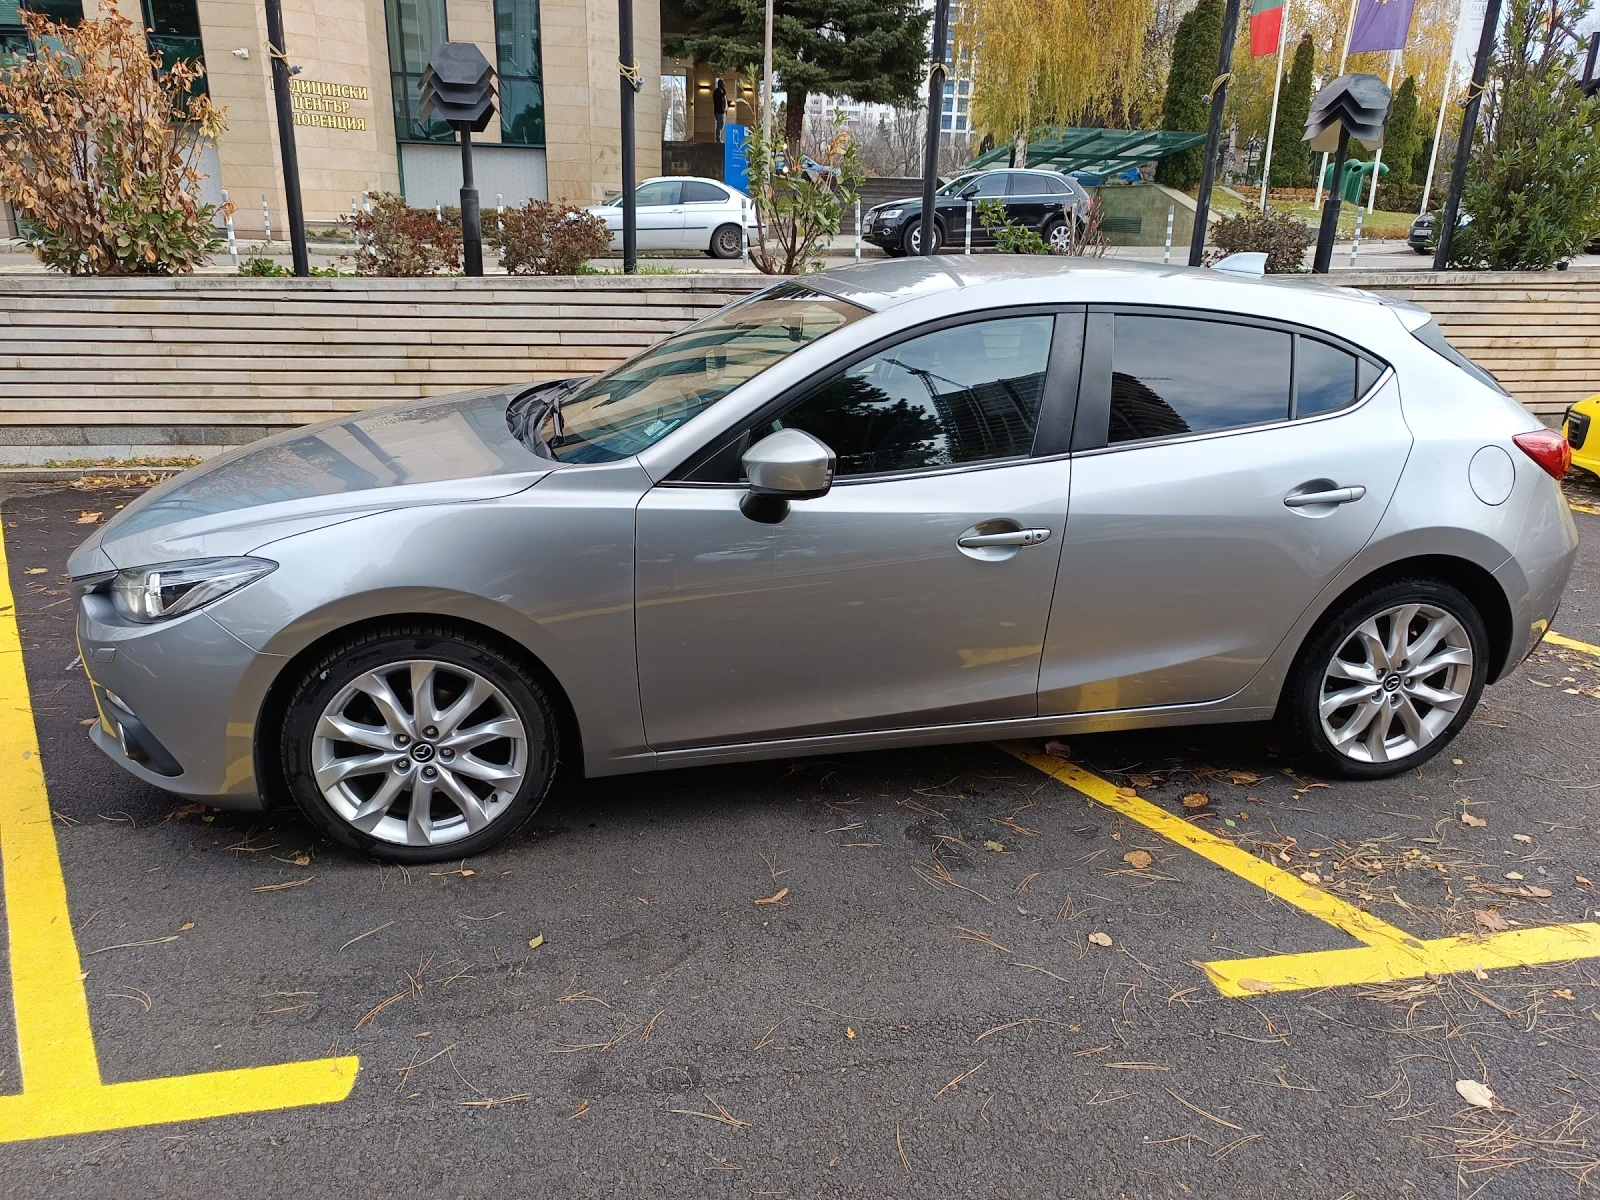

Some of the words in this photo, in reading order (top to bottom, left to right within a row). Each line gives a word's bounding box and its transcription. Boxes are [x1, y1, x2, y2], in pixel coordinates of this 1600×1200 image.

[269, 76, 368, 100] ДИЦИНСКИ
[293, 96, 350, 113] ЦЕНТЪР
[292, 113, 366, 132] ЛОРЕНЦИЯ
